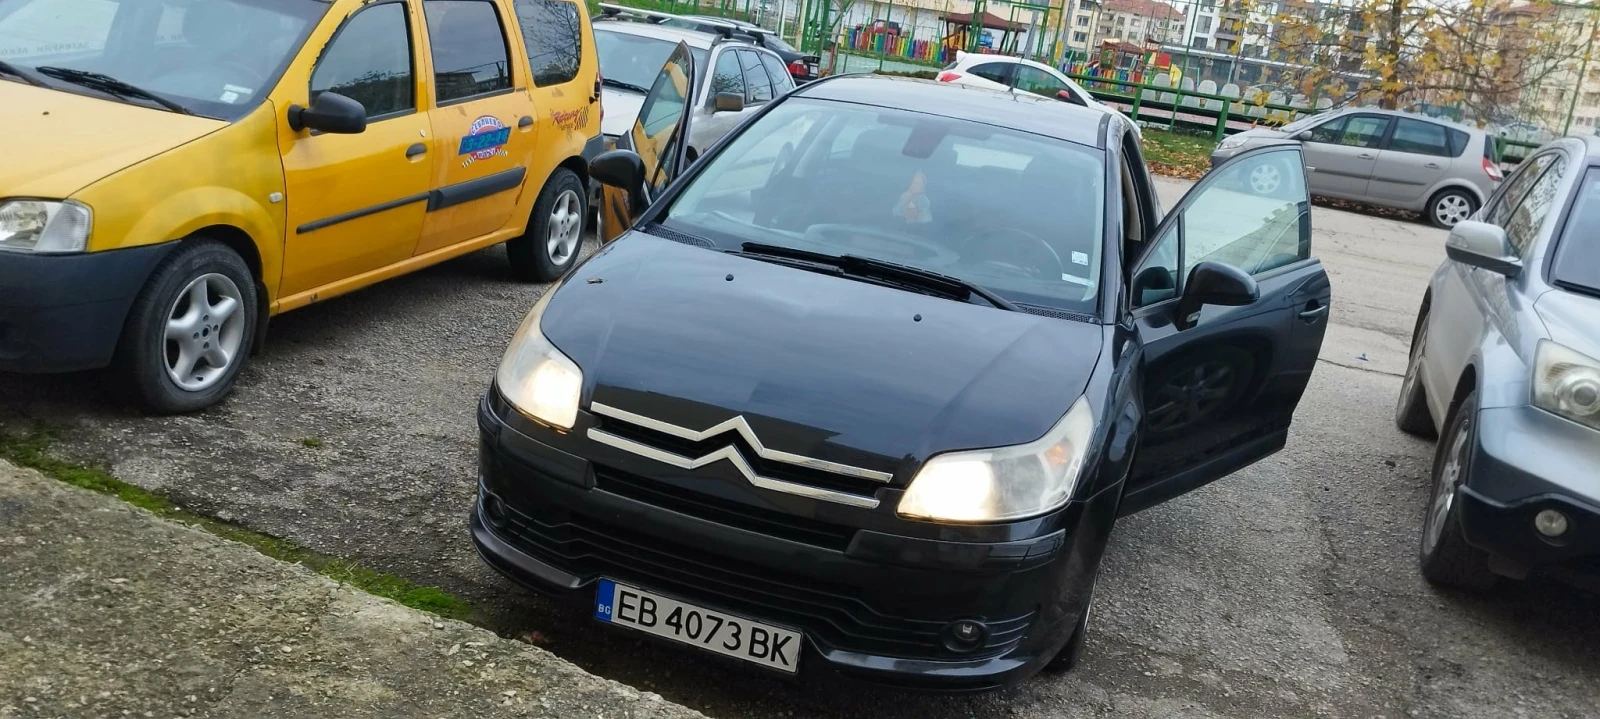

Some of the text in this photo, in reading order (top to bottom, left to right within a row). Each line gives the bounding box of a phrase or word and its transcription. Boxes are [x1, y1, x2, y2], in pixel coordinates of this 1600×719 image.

[598, 603, 611, 615] BG
[617, 590, 793, 666] EB 4073 BK
